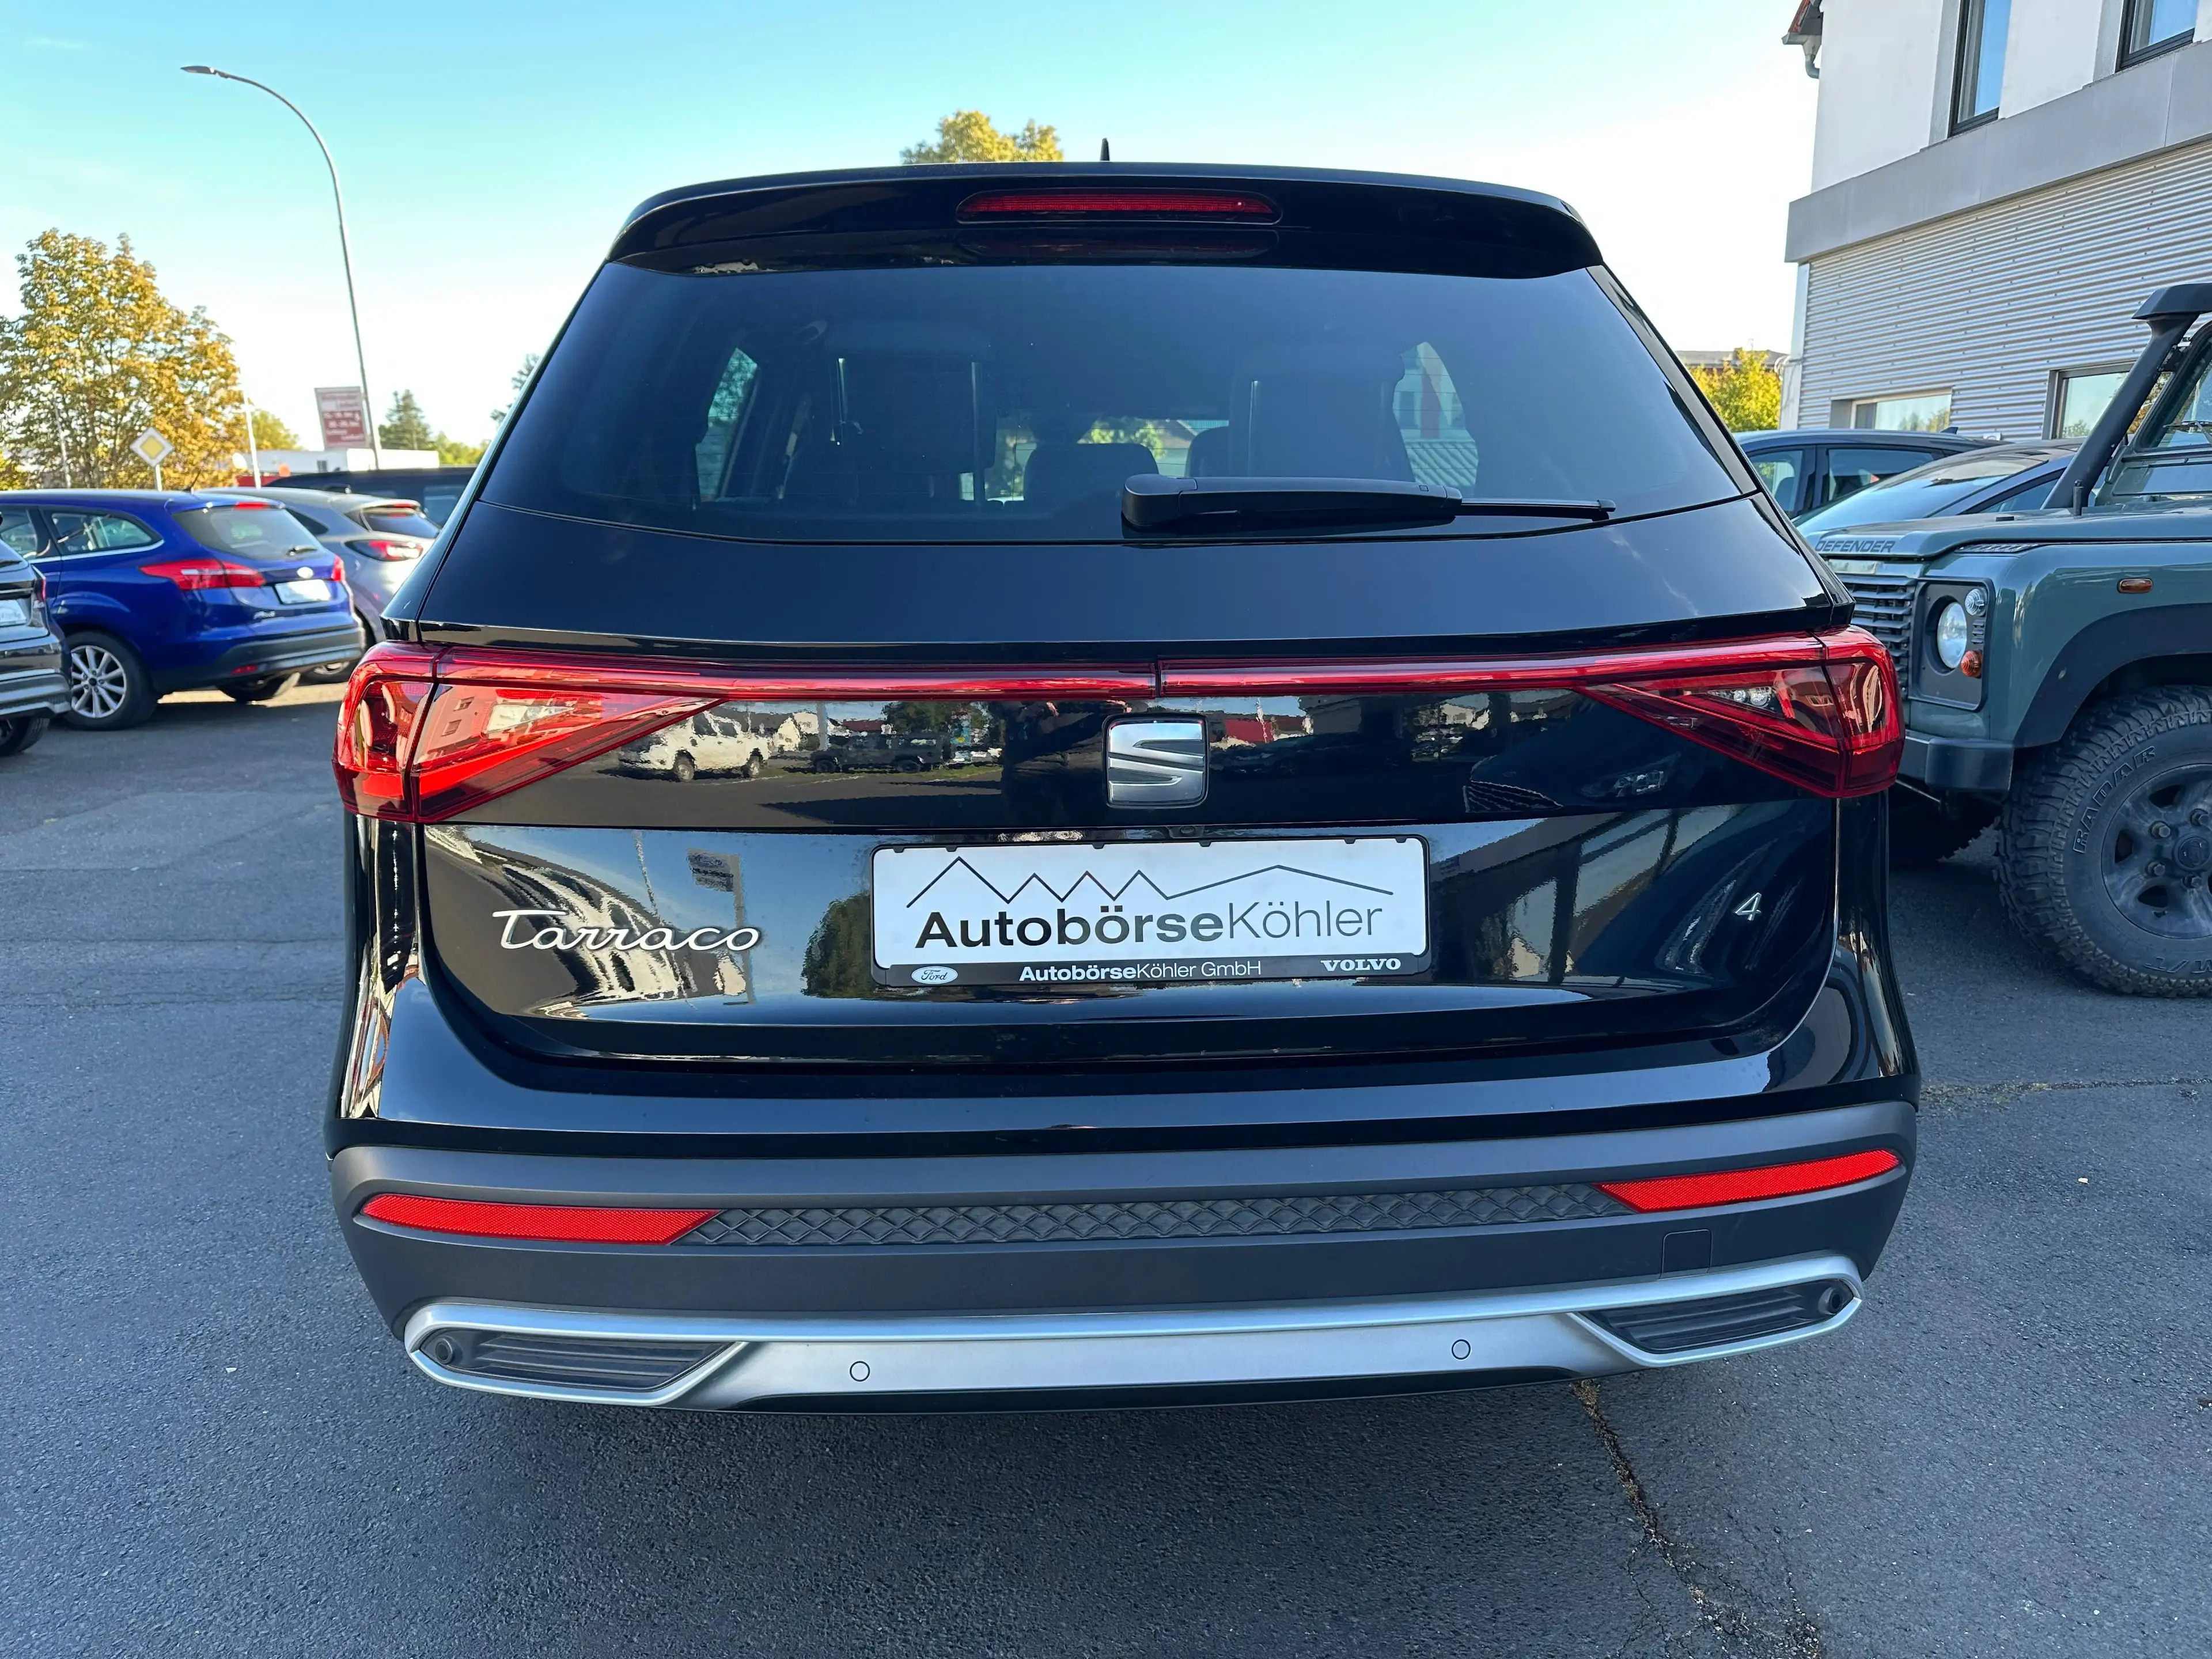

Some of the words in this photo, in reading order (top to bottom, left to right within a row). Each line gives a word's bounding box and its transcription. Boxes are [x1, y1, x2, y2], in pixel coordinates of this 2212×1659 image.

[1815, 540, 1896, 553] DEFENDER
[2073, 745, 2155, 854] RADAR
[1734, 892, 1763, 921] 4
[491, 909, 760, 951] Tarraco
[914, 900, 1383, 949] AutobörseKöhler
[921, 969, 948, 981] Ford
[1018, 962, 1196, 982] AutobörseKöhler
[1200, 960, 1262, 978] GmbH
[1320, 957, 1402, 972] VOLVO
